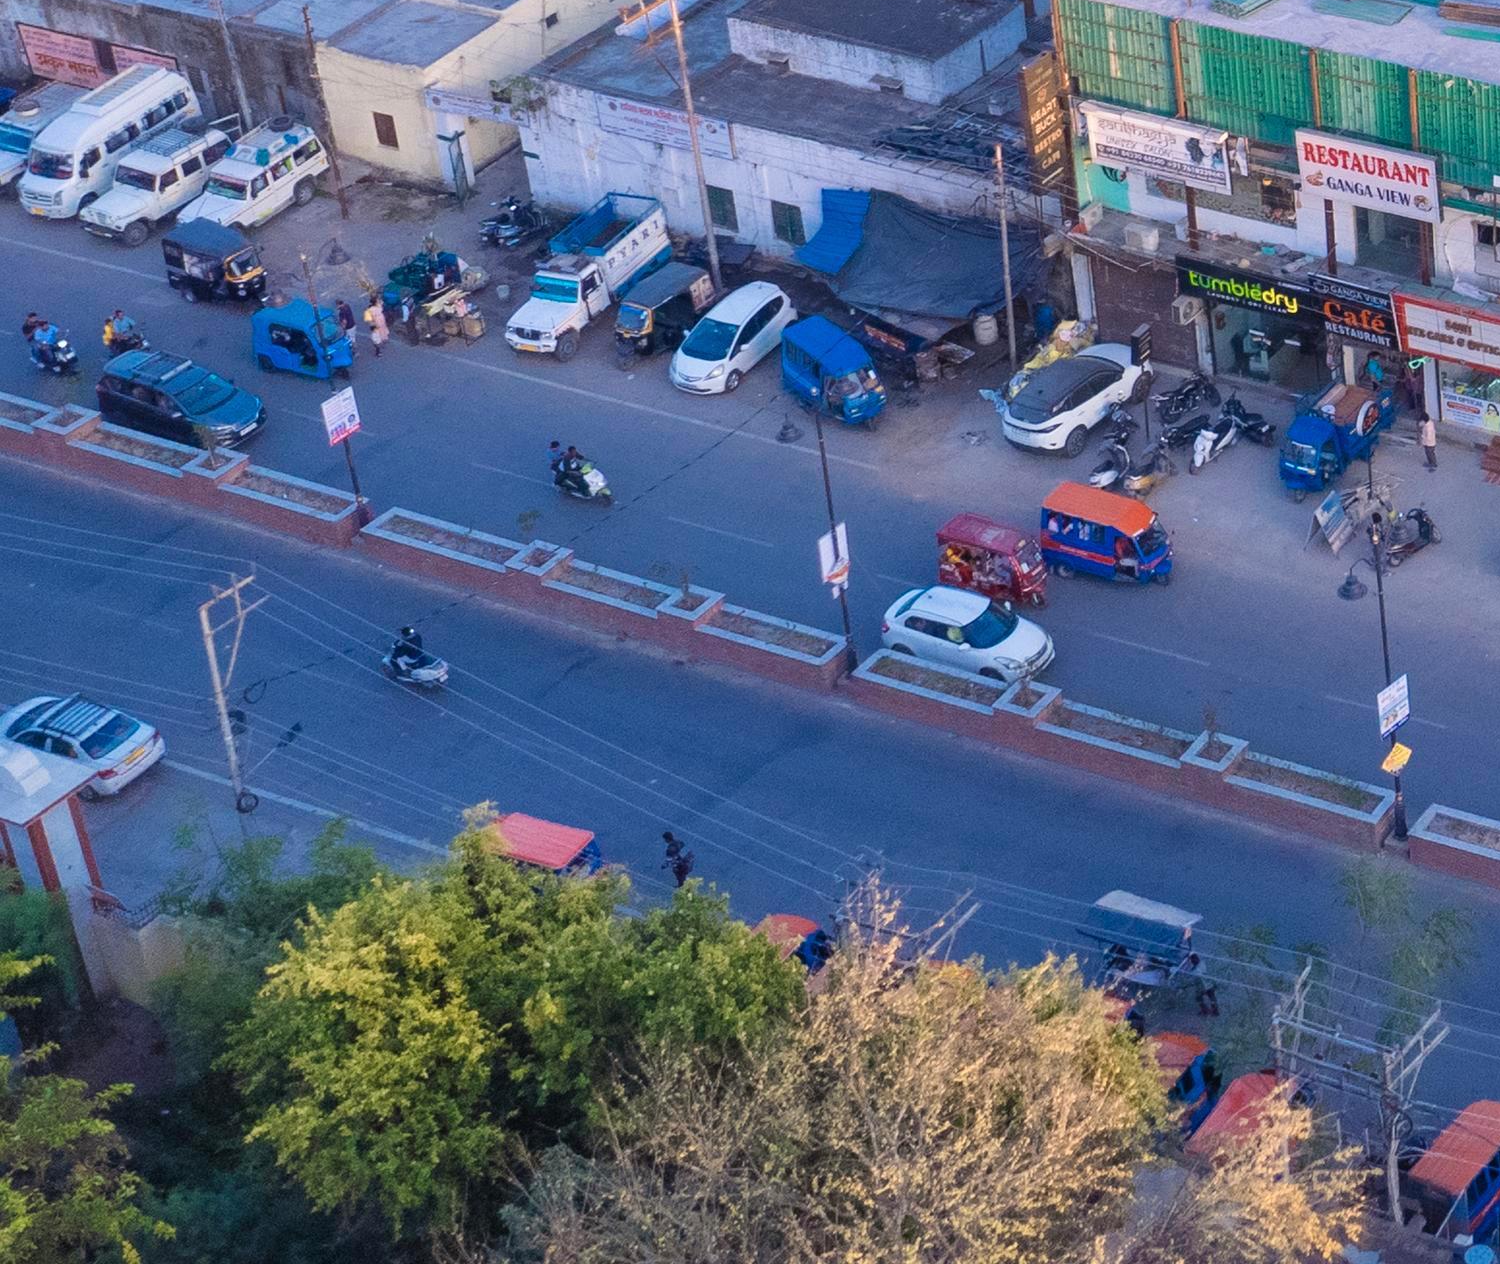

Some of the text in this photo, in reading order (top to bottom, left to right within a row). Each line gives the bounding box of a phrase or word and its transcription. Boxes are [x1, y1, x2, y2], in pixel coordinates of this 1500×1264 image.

[1303, 142, 1430, 187] RESTAURANT
[1327, 176, 1411, 206] GANGA VIEW
[1189, 270, 1298, 313] tumbledry
[1323, 301, 1385, 334] Café
[1325, 321, 1391, 347] RESTAURANT
